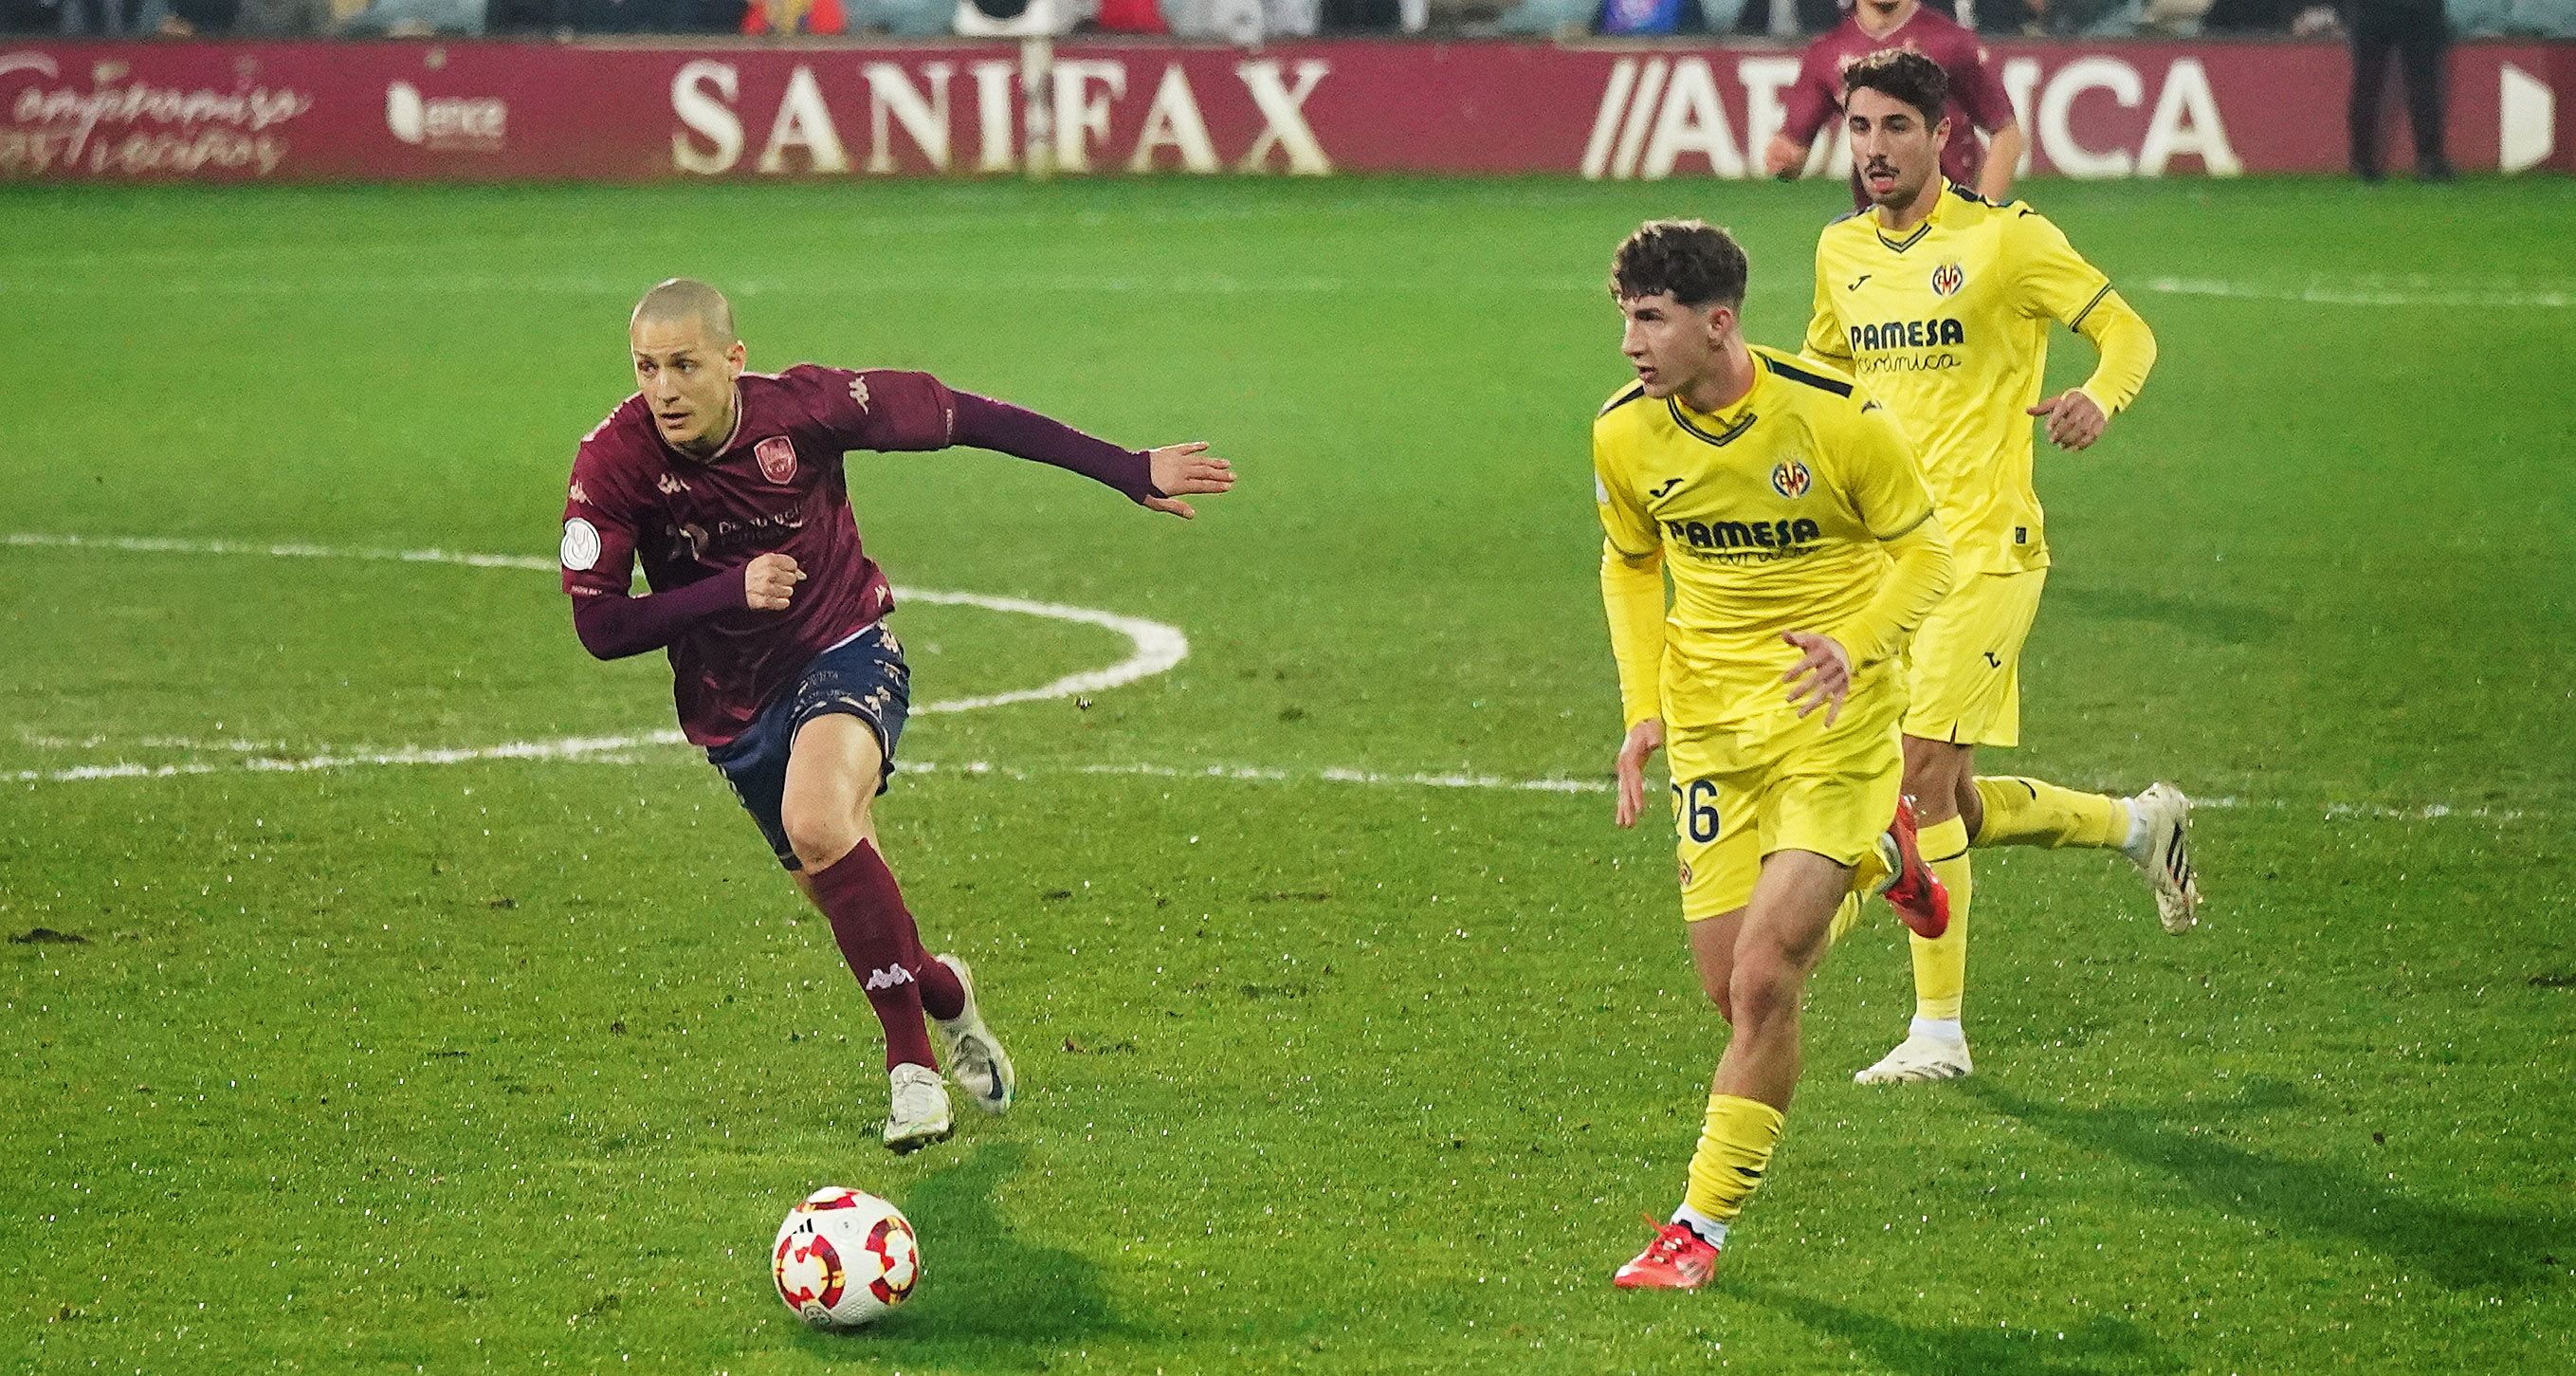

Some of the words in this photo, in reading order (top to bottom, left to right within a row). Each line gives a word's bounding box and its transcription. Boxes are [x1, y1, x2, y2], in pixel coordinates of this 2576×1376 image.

[670, 59, 1332, 174] SANIFAX
[1643, 57, 2243, 178] ABCA
[1850, 318, 1964, 353] PAMESA
[1666, 518, 1821, 548] PAMESA
